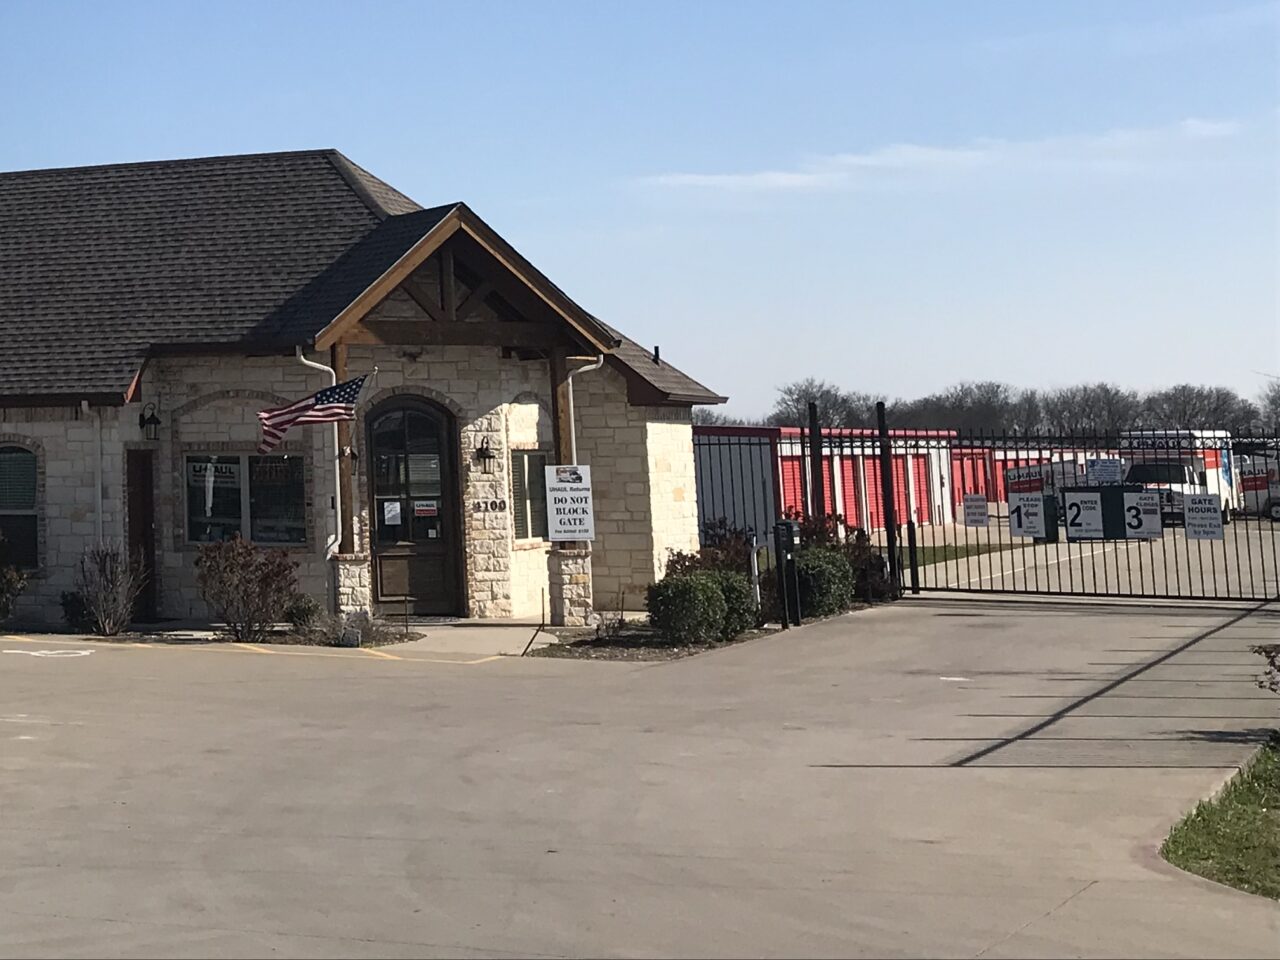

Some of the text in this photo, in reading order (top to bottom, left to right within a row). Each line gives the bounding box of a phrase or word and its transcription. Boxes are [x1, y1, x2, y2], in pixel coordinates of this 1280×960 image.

[553, 496, 589, 505] DO NOT
[555, 507, 589, 516] BLOCK
[1187, 506, 1218, 514] HOURS
[1010, 505, 1023, 528] 1
[1068, 502, 1083, 528] 2
[1126, 505, 1144, 530] 3
[558, 517, 585, 526] GATE
